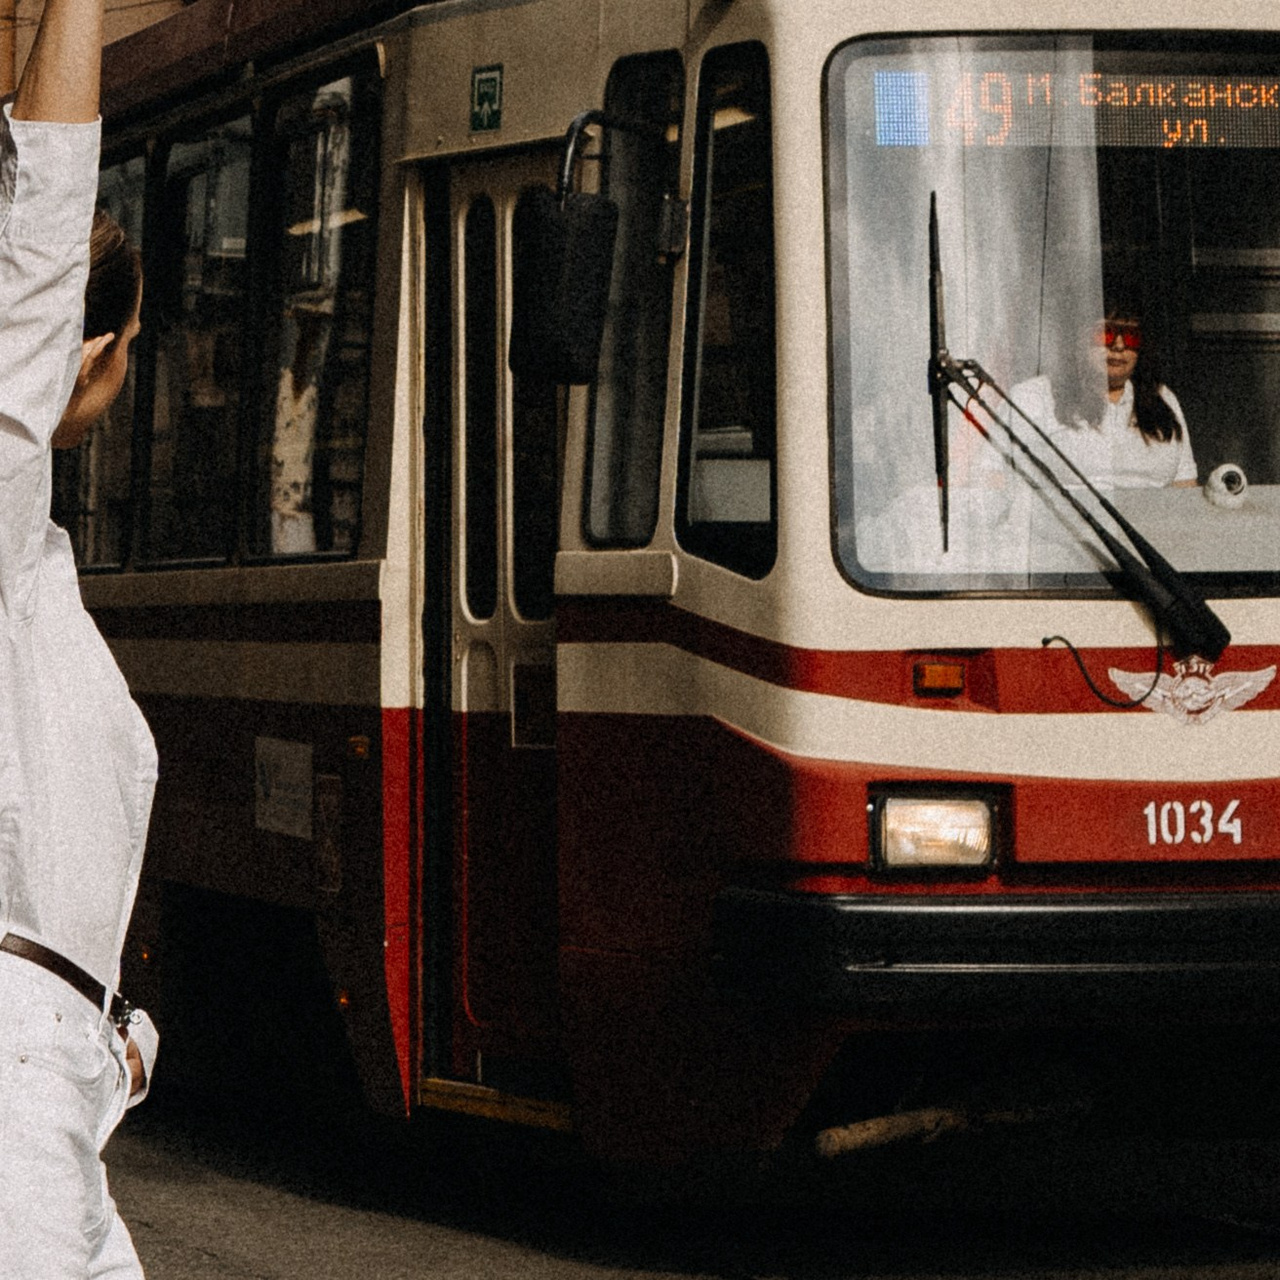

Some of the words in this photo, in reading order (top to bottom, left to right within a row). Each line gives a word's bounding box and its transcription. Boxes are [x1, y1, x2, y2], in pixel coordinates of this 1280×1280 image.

[945, 71, 1013, 147] 49
[1162, 119, 1225, 149] ул.
[1143, 799, 1242, 845] 1034
